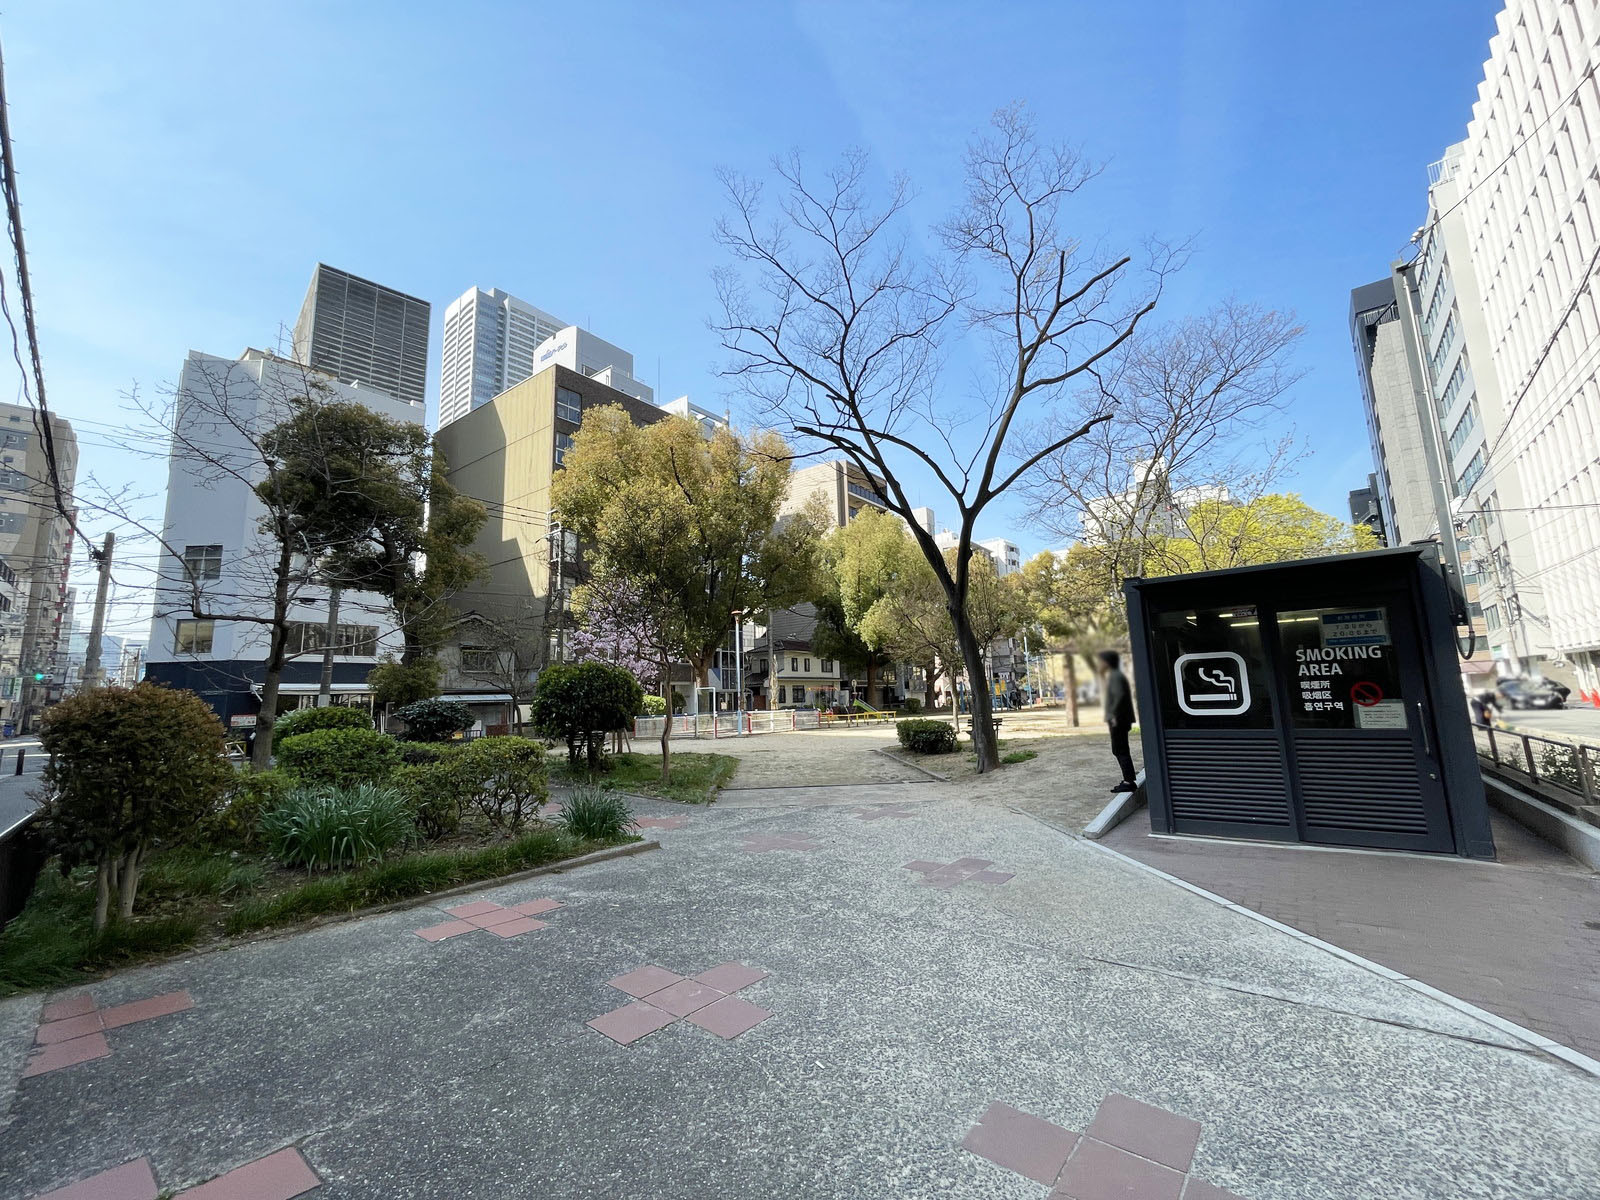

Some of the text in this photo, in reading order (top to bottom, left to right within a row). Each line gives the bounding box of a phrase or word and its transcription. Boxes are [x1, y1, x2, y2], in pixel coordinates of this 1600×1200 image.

[1296, 645, 1382, 662] SMOKING
[1298, 663, 1343, 676] AREA
[1300, 680, 1330, 689] 喫煙所
[1302, 691, 1332, 700] 吸烟区
[1304, 702, 1344, 711] 흡연구역
